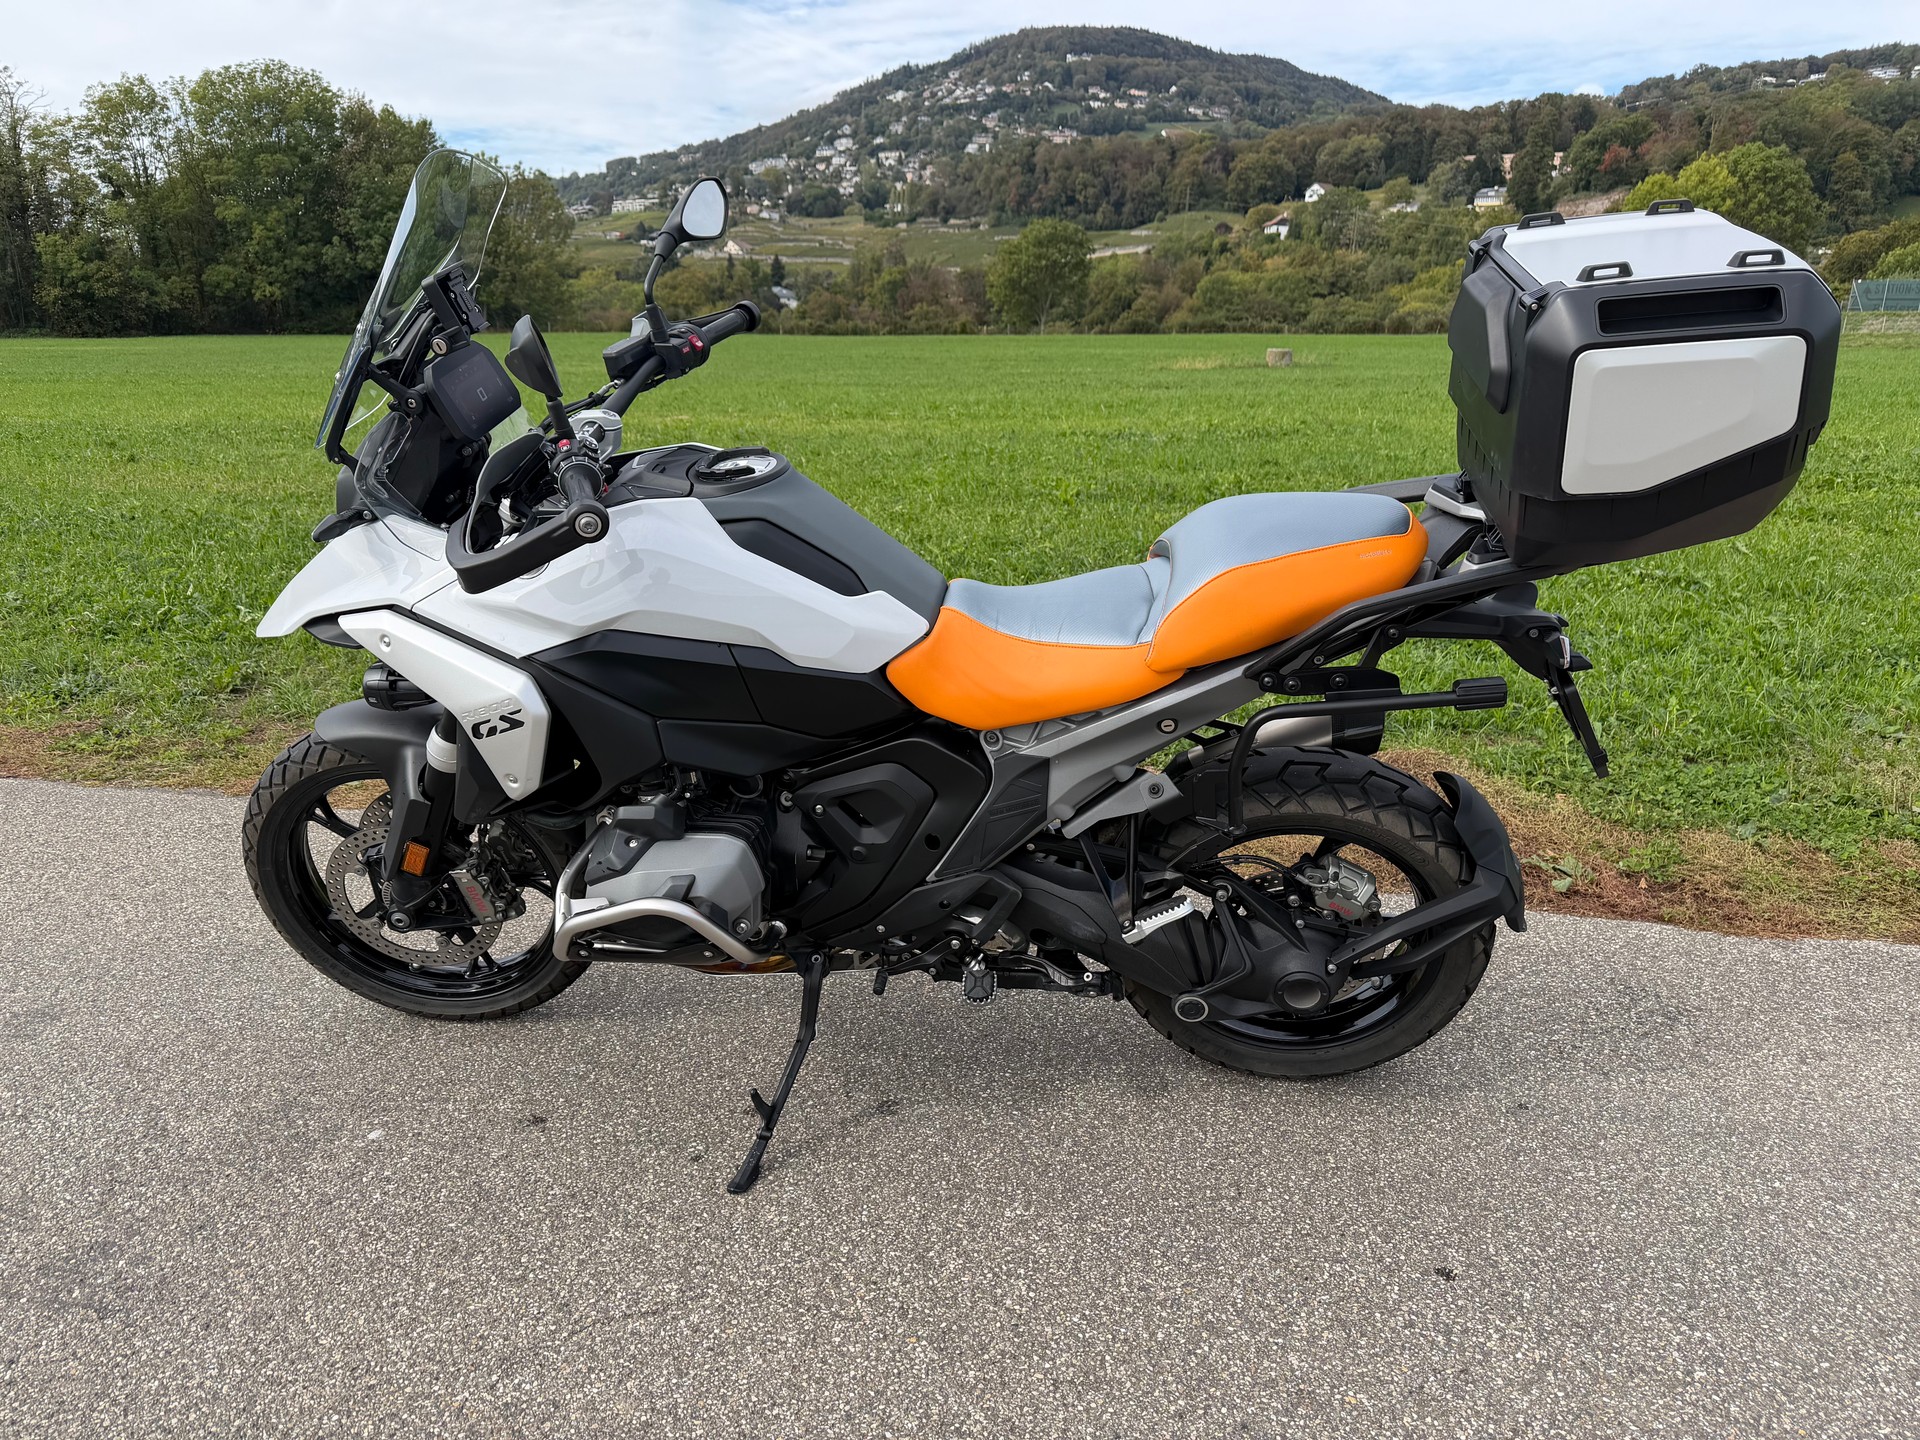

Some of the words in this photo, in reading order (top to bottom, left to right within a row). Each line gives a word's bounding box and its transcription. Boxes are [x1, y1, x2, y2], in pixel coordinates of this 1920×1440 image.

[471, 708, 525, 739] GS
[466, 886, 488, 912] BMW
[1328, 901, 1354, 916] BMW
